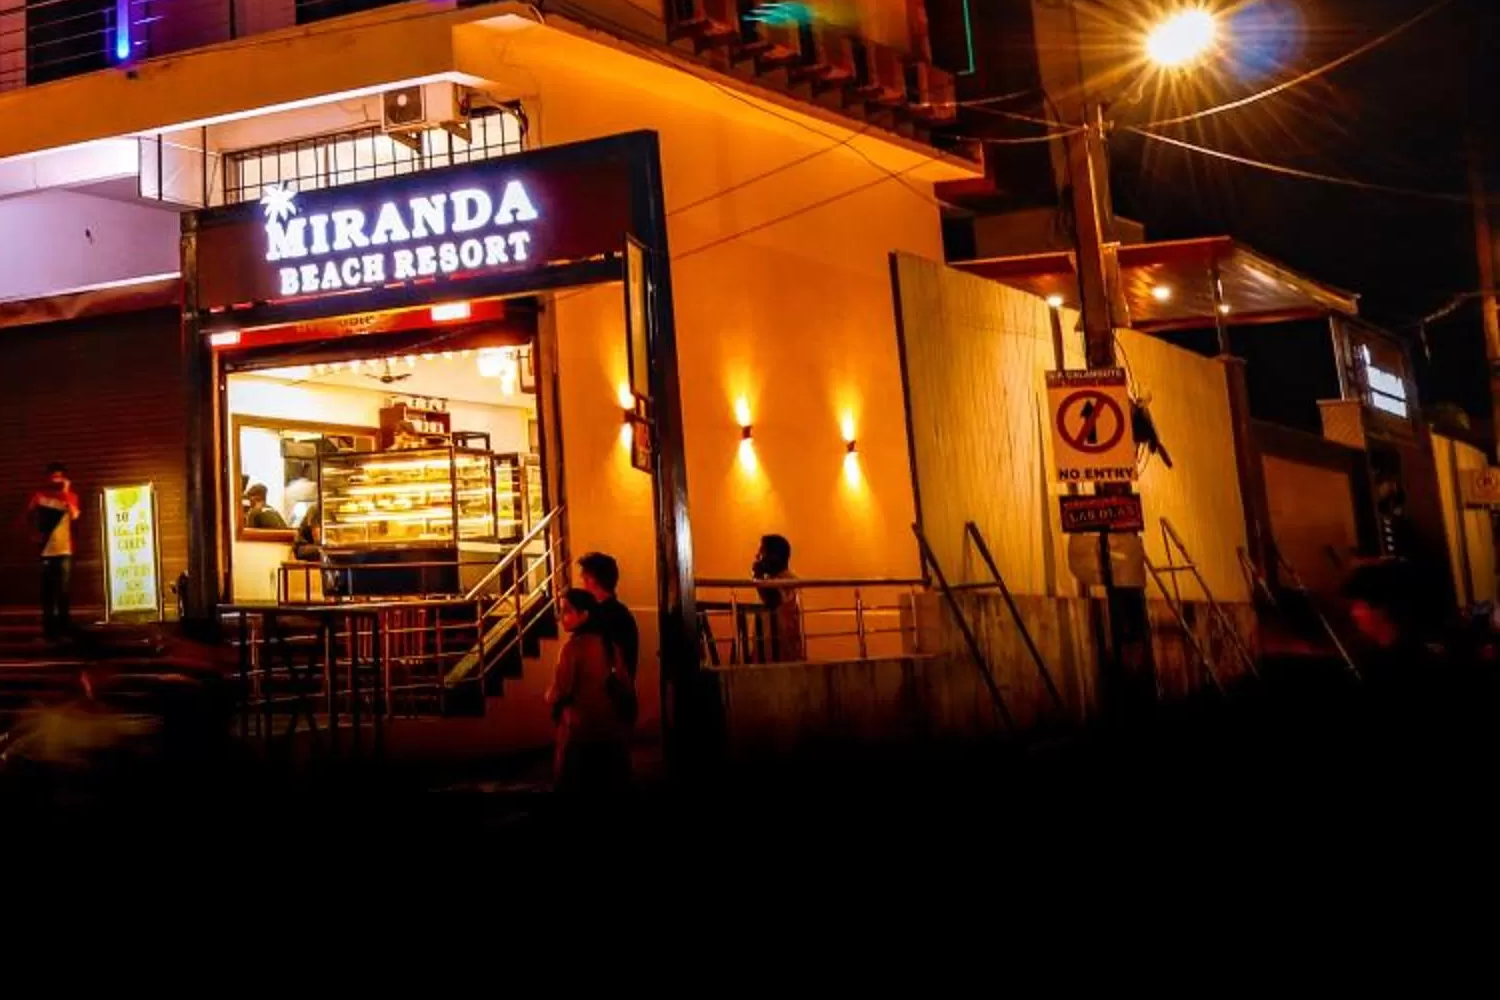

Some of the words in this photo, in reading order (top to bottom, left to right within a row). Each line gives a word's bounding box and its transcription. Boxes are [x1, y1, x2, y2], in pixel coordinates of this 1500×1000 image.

[266, 181, 539, 261] MIRANDA
[280, 258, 384, 296] BEACH
[394, 231, 531, 280] RESORT
[1059, 468, 1080, 480] NO
[1085, 466, 1134, 480] ENTRY
